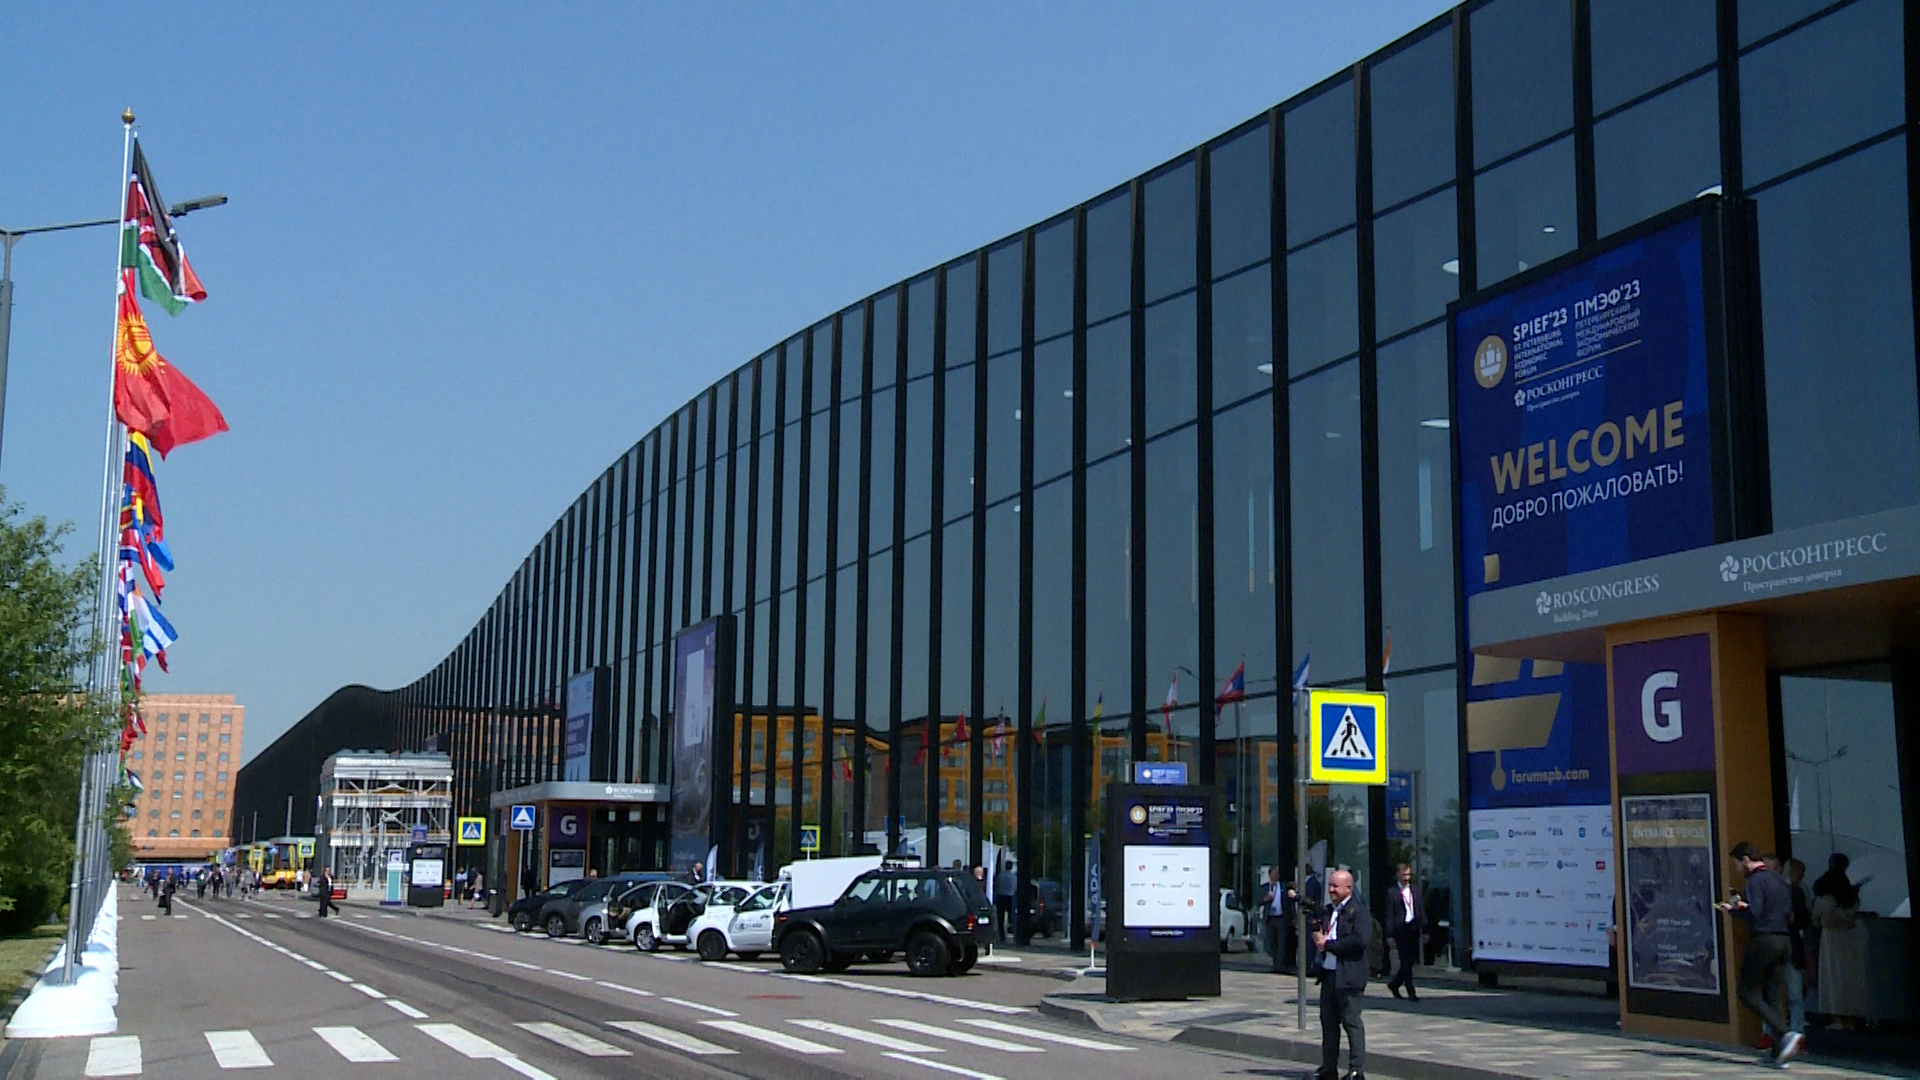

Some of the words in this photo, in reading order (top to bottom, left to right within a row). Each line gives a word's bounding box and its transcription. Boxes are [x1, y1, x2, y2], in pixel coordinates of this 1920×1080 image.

[1513, 307, 1568, 342] SPIEF'23
[1526, 365, 1604, 402] РОСКОНГРЕСС
[1490, 400, 1685, 494] WELCOME
[1491, 495, 1548, 531] ДОБРО
[1552, 460, 1684, 514] ПОЖАЛОВАТЬ!
[1742, 532, 1888, 576] РОСКОНГРЕСС
[1553, 573, 1660, 608] ROSCONGRESS
[1641, 671, 1683, 743] G
[1512, 765, 1590, 786] forumspb.com
[560, 815, 577, 836] G
